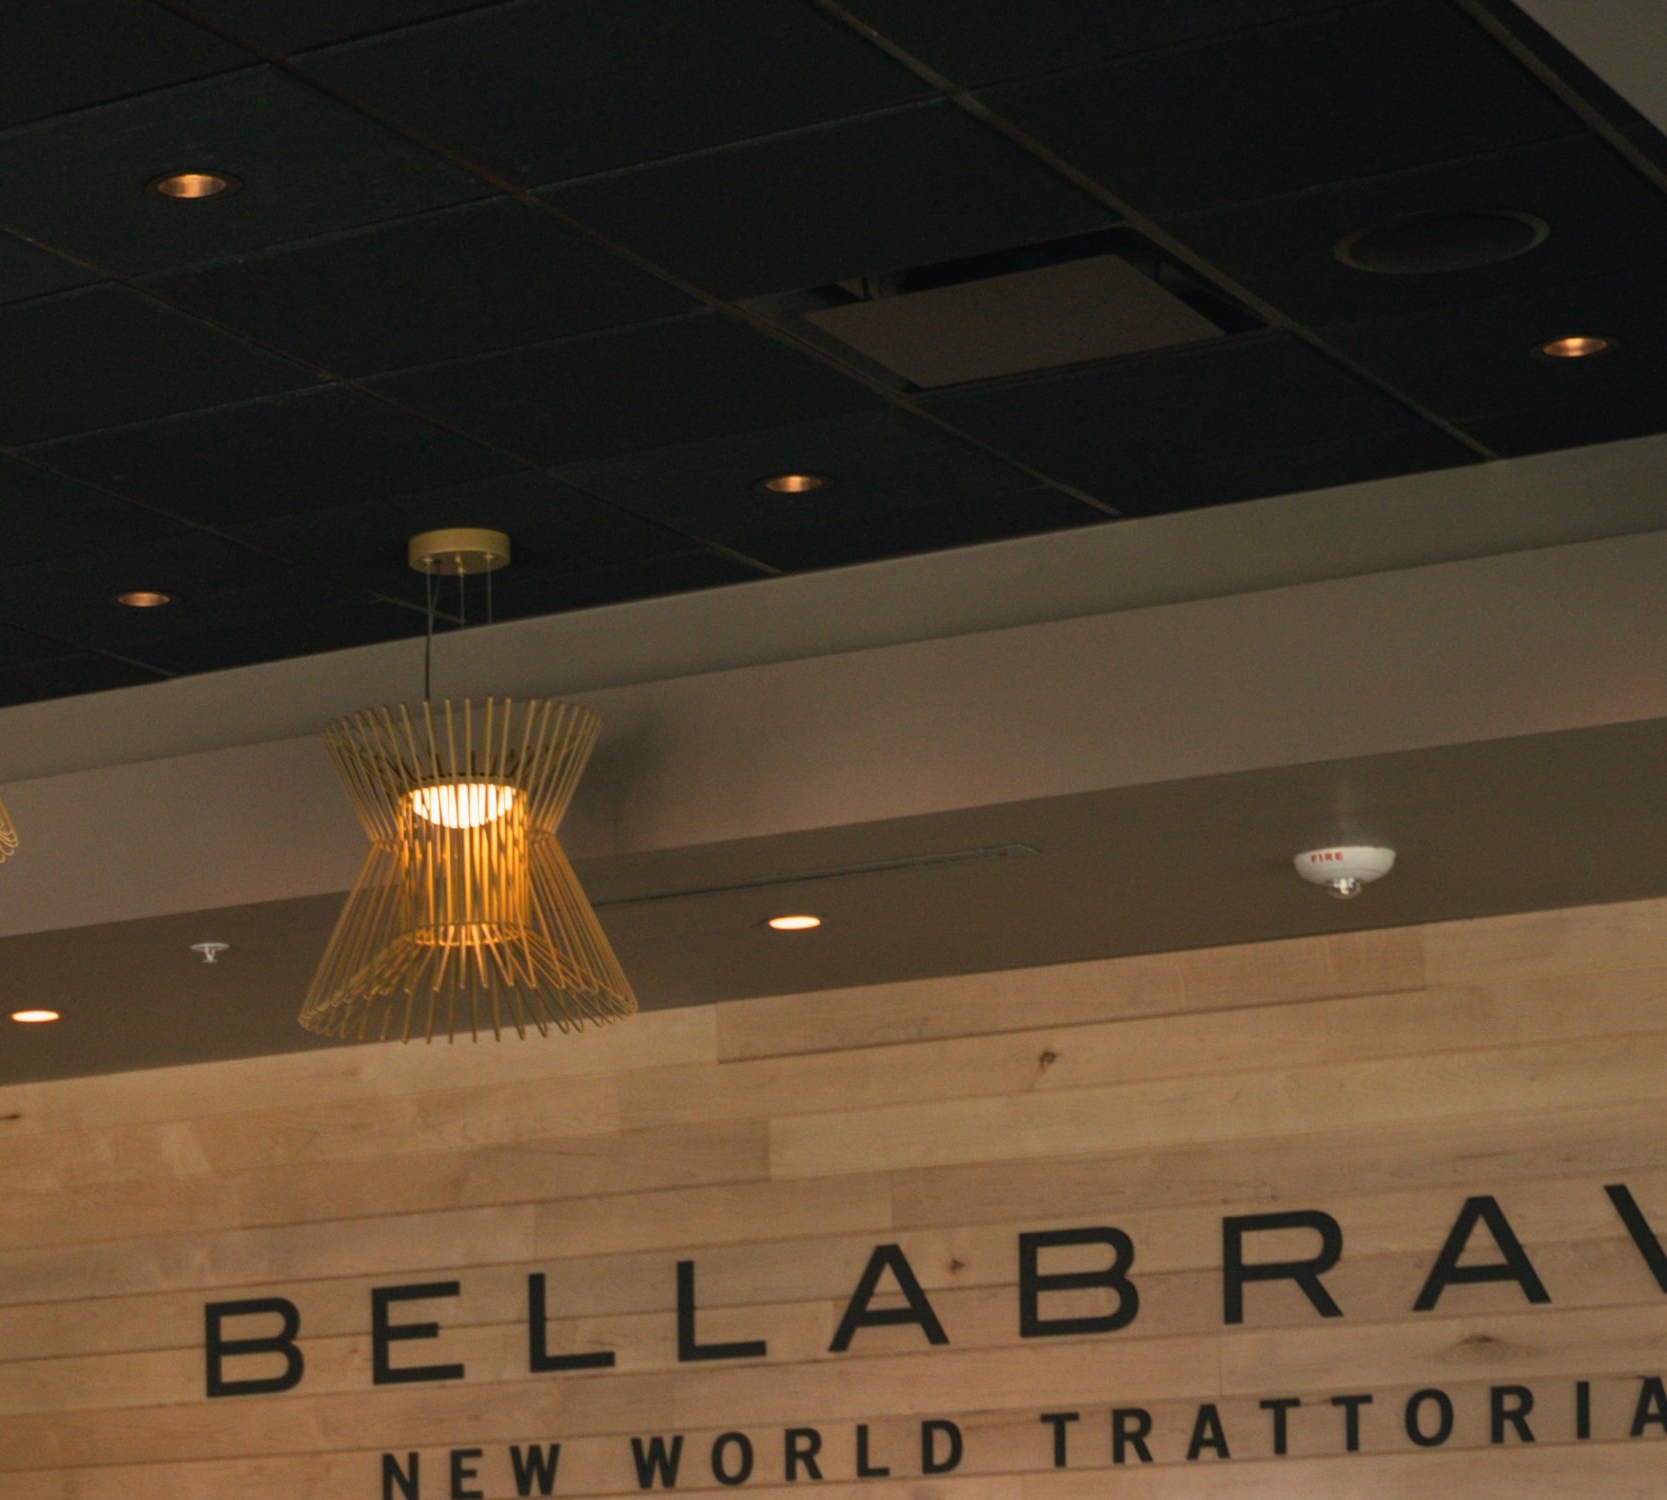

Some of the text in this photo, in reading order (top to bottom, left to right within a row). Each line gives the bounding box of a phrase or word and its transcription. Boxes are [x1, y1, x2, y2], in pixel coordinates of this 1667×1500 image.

[1311, 852, 1343, 863] FIRE
[630, 1418, 964, 1490] WORLD
[1040, 1374, 1667, 1468] TRATTORIA
